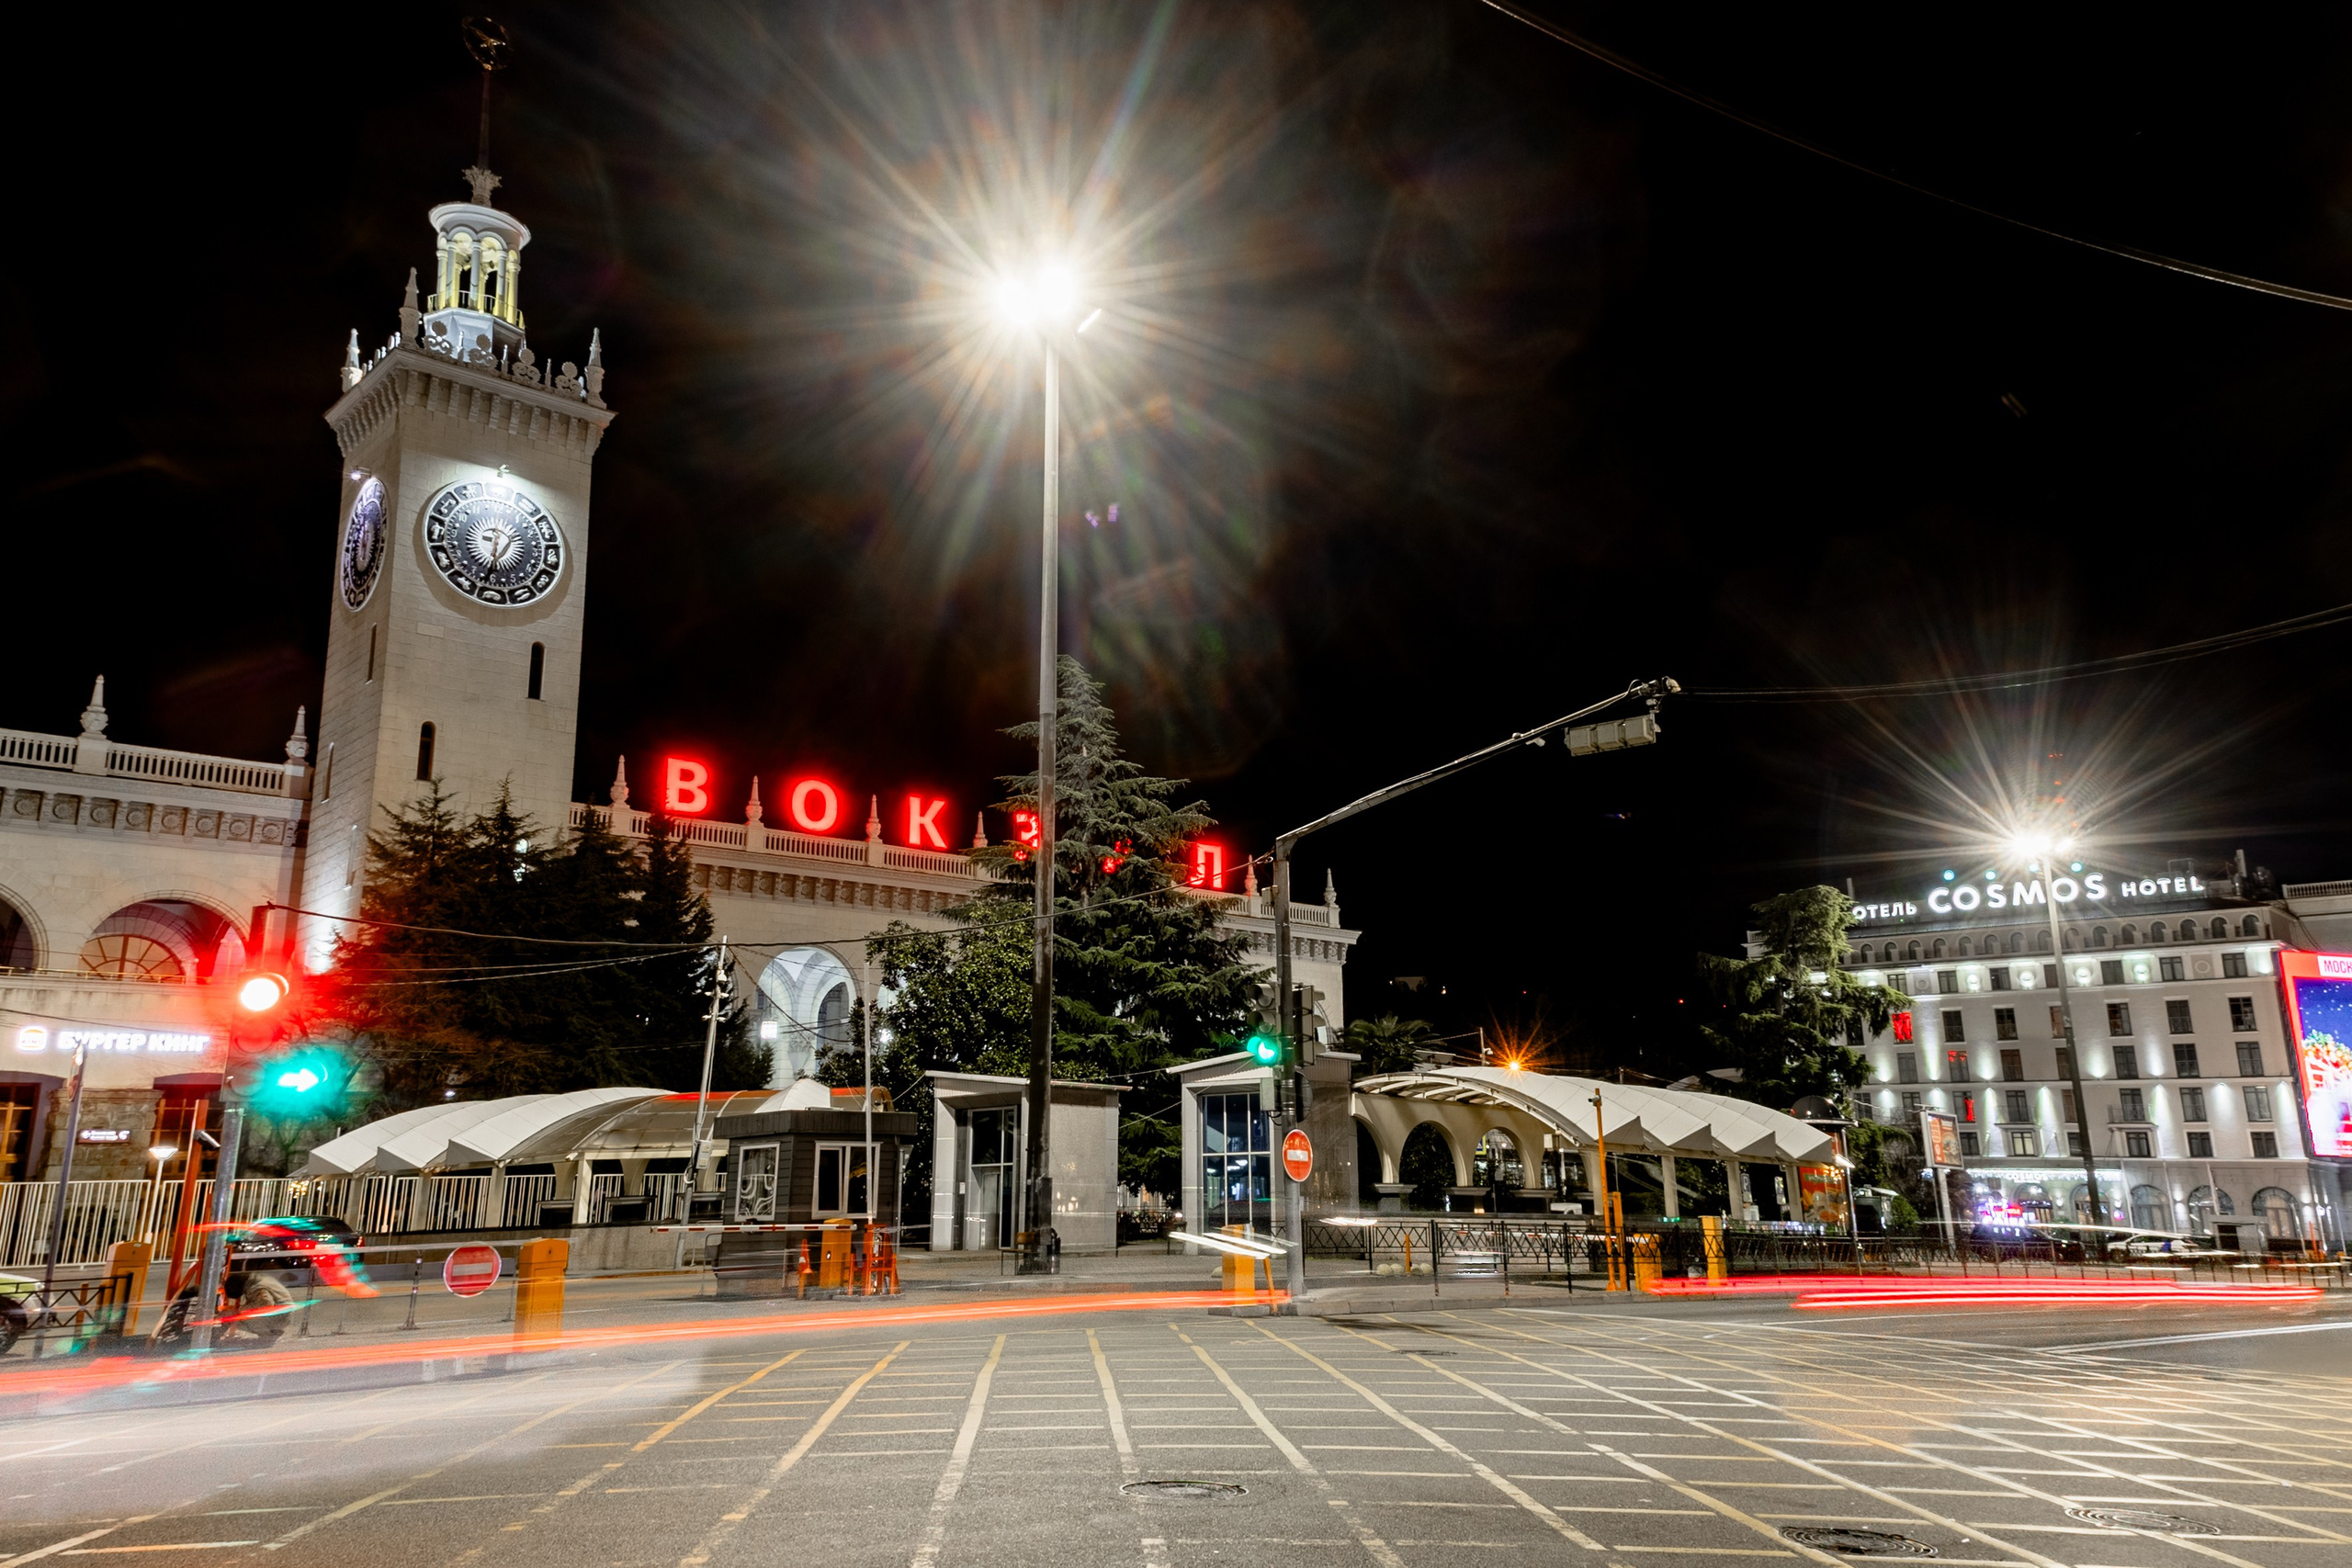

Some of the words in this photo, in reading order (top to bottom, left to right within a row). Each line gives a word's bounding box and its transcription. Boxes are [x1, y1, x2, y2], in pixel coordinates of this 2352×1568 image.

[665, 756, 1224, 890] ВОКЗЛ
[1928, 872, 2108, 914] COSMOS
[2121, 875, 2205, 897] HOTEL
[1852, 901, 1917, 919] ОТЕЛЬ
[57, 1031, 147, 1052] БУРГЕР
[147, 1033, 211, 1054] КИНГ
